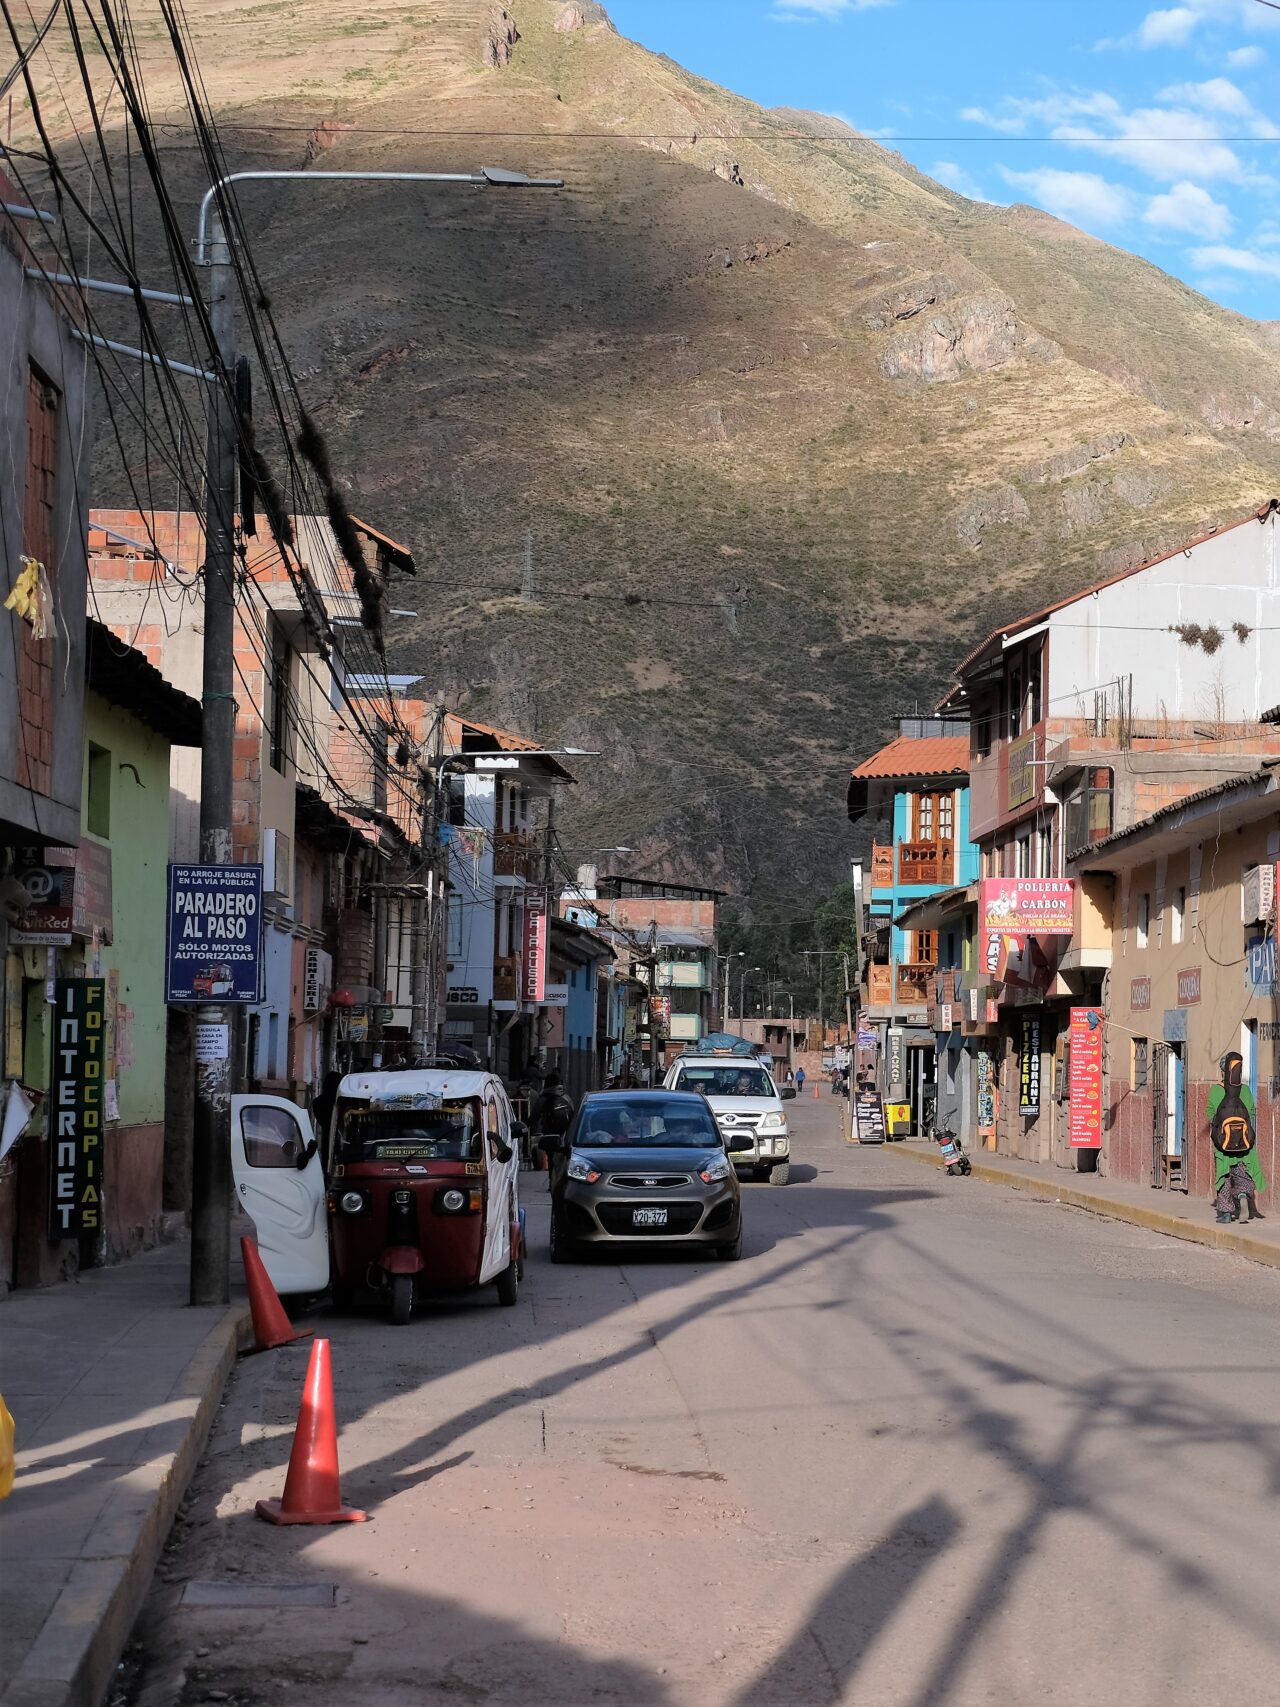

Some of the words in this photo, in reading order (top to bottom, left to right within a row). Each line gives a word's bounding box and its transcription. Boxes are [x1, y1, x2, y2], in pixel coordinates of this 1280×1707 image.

[190, 870, 223, 878] ARROJE
[224, 871, 257, 879] BASURA
[204, 877, 218, 885] VÍA
[220, 877, 255, 886] PÚBLICA
[1018, 882, 1071, 892] POLLERIA
[175, 891, 256, 916] PARADERO
[1021, 897, 1066, 909] CARBÓN
[182, 916, 202, 938] AL
[207, 916, 247, 939] PASO
[174, 952, 255, 960] AUTORIZADAS
[178, 942, 209, 951] SÓLO
[211, 943, 252, 952] MOTOS
[306, 950, 318, 1008] CARNICERIA
[891, 1036, 900, 1083] RESTAURANT
[1020, 1021, 1030, 1105] PIZZERIA
[1030, 1021, 1040, 1105] RESTAURANT
[979, 1056, 987, 1126] INTERNET
[57, 988, 79, 1228] INTERNET
[81, 986, 102, 1228] FOTOCOPIAS
[1020, 1106, 1039, 1114] LAUNDRY
[634, 1211, 667, 1223] X20-377
